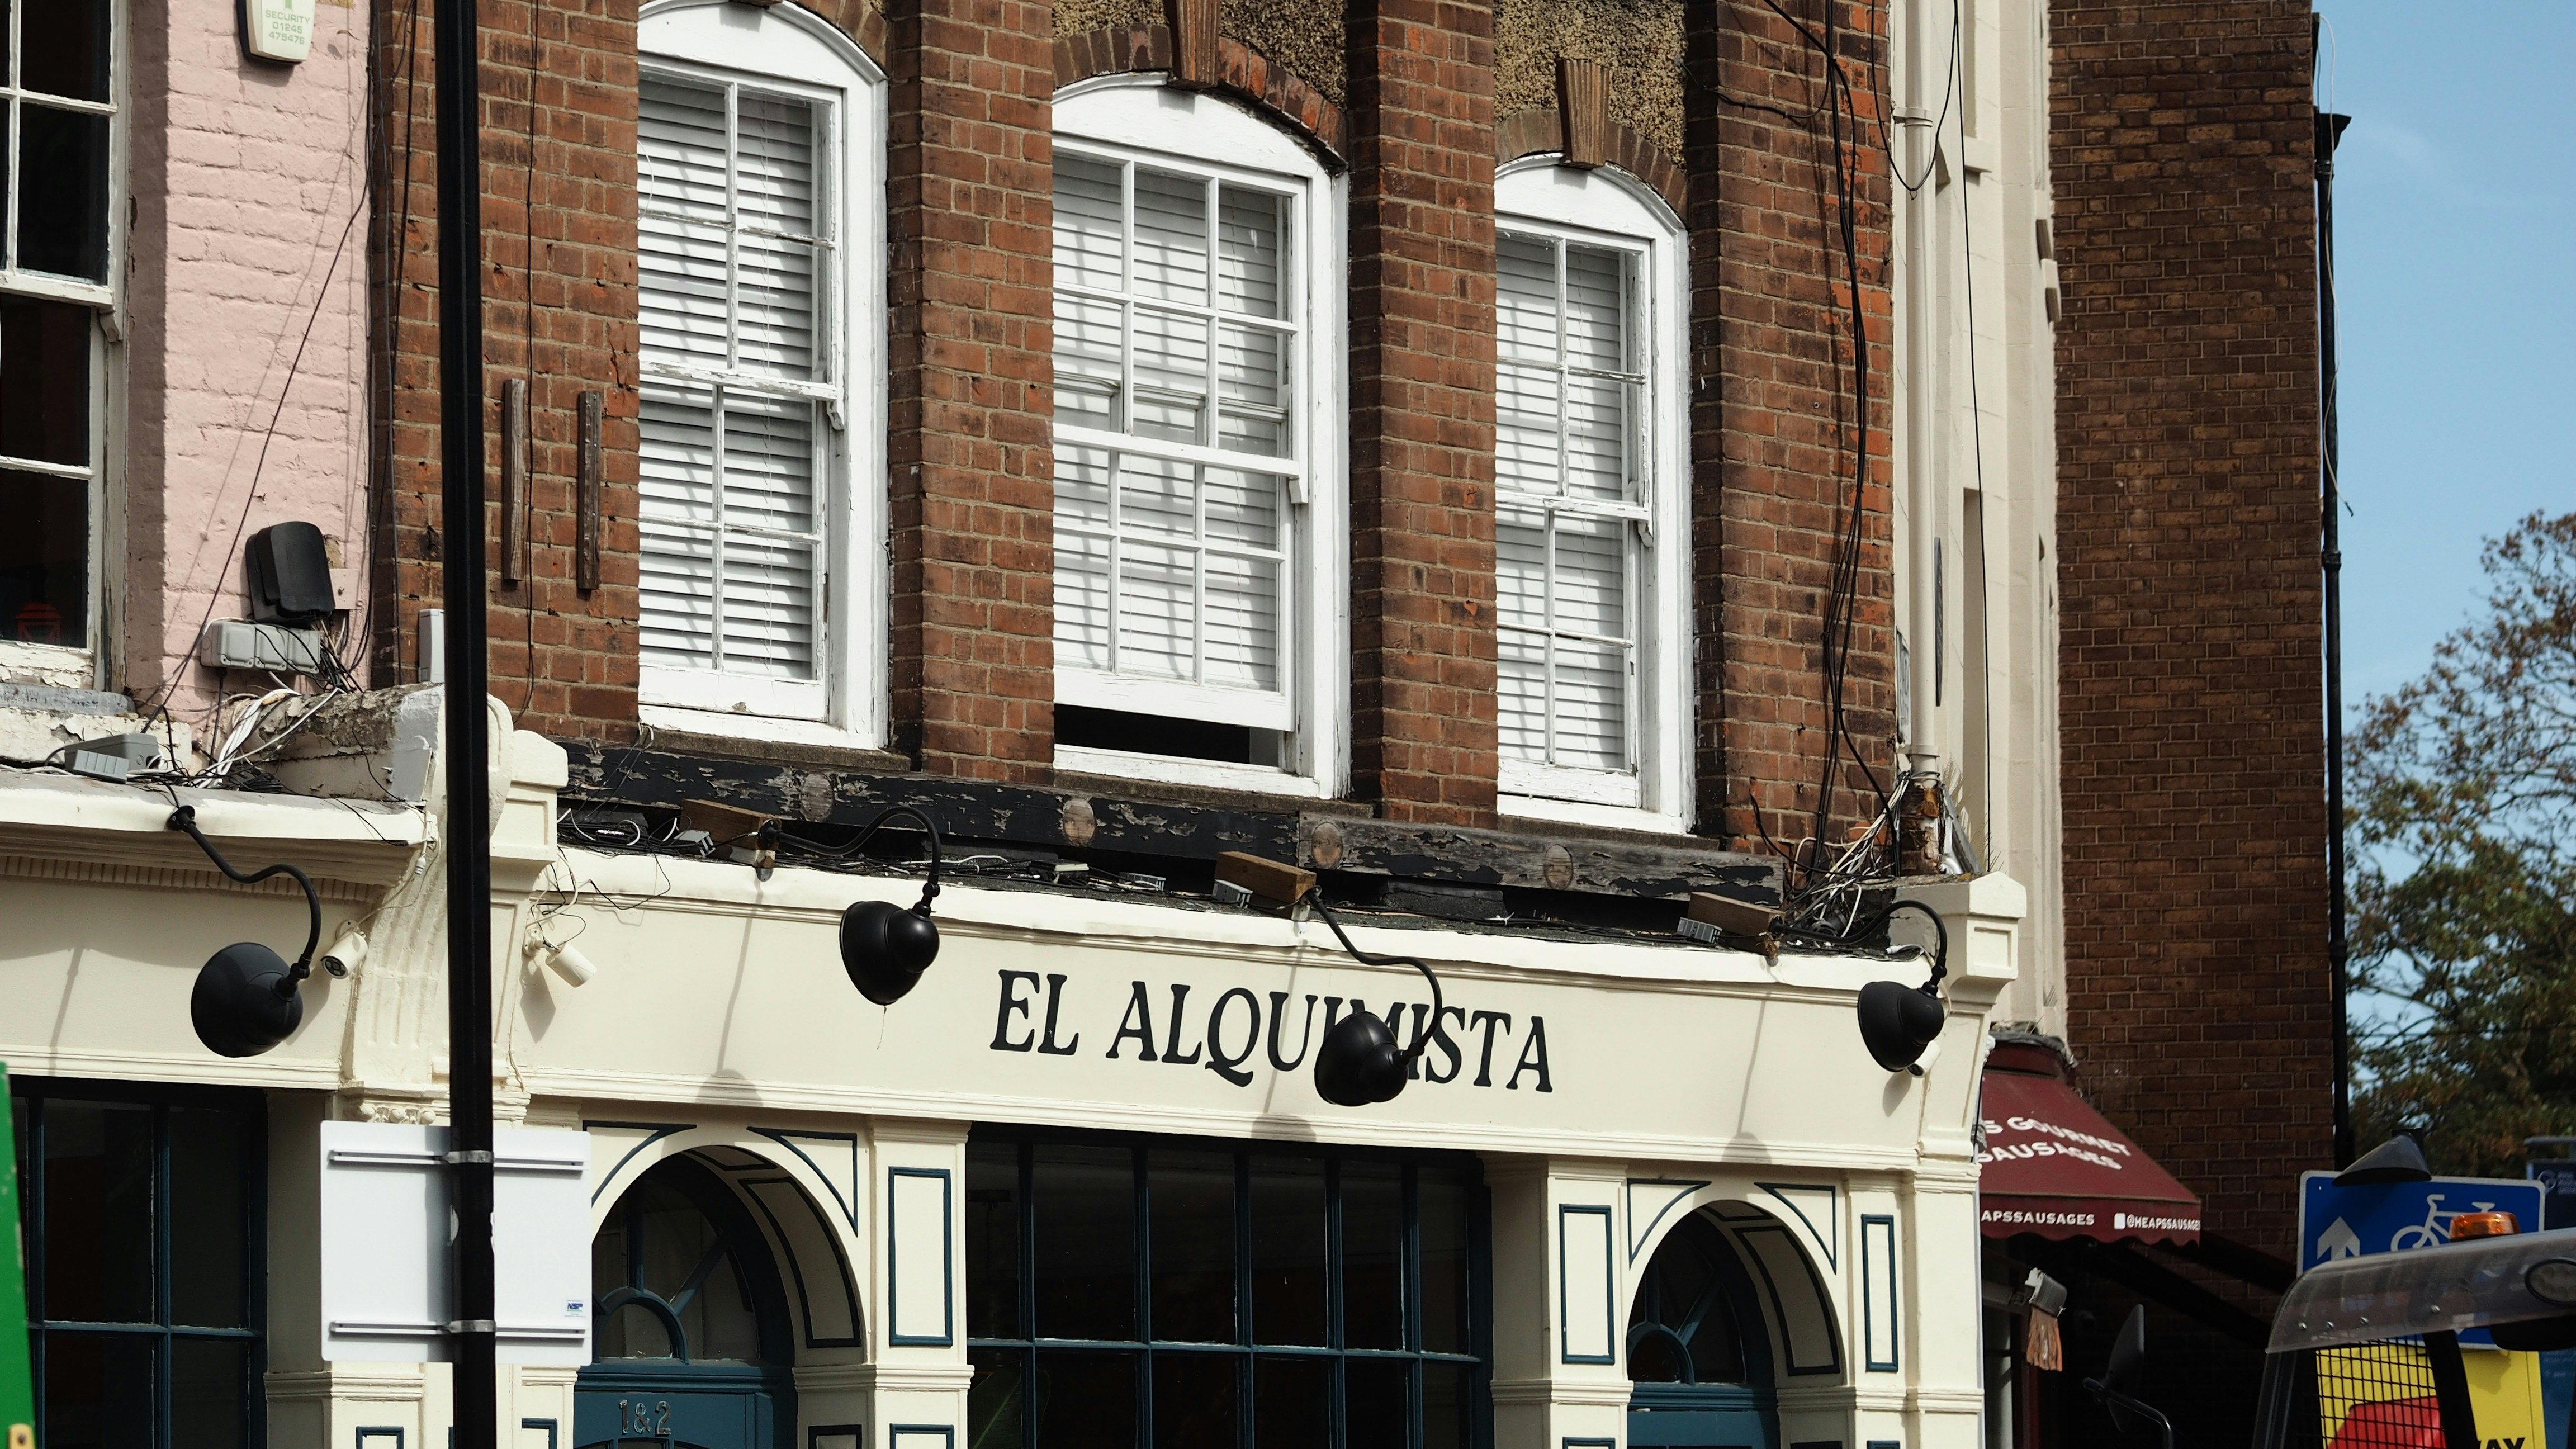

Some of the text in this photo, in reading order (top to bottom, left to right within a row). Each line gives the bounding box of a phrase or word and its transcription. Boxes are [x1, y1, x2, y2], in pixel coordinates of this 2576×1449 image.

[265, 10, 310, 25] SECURITY
[272, 21, 303, 34] 01245
[269, 31, 305, 45] 475476
[990, 970, 1078, 1055] EL
[2006, 1117, 2131, 1156] GOURMET
[1978, 1142, 2122, 1170] SAUSAGES
